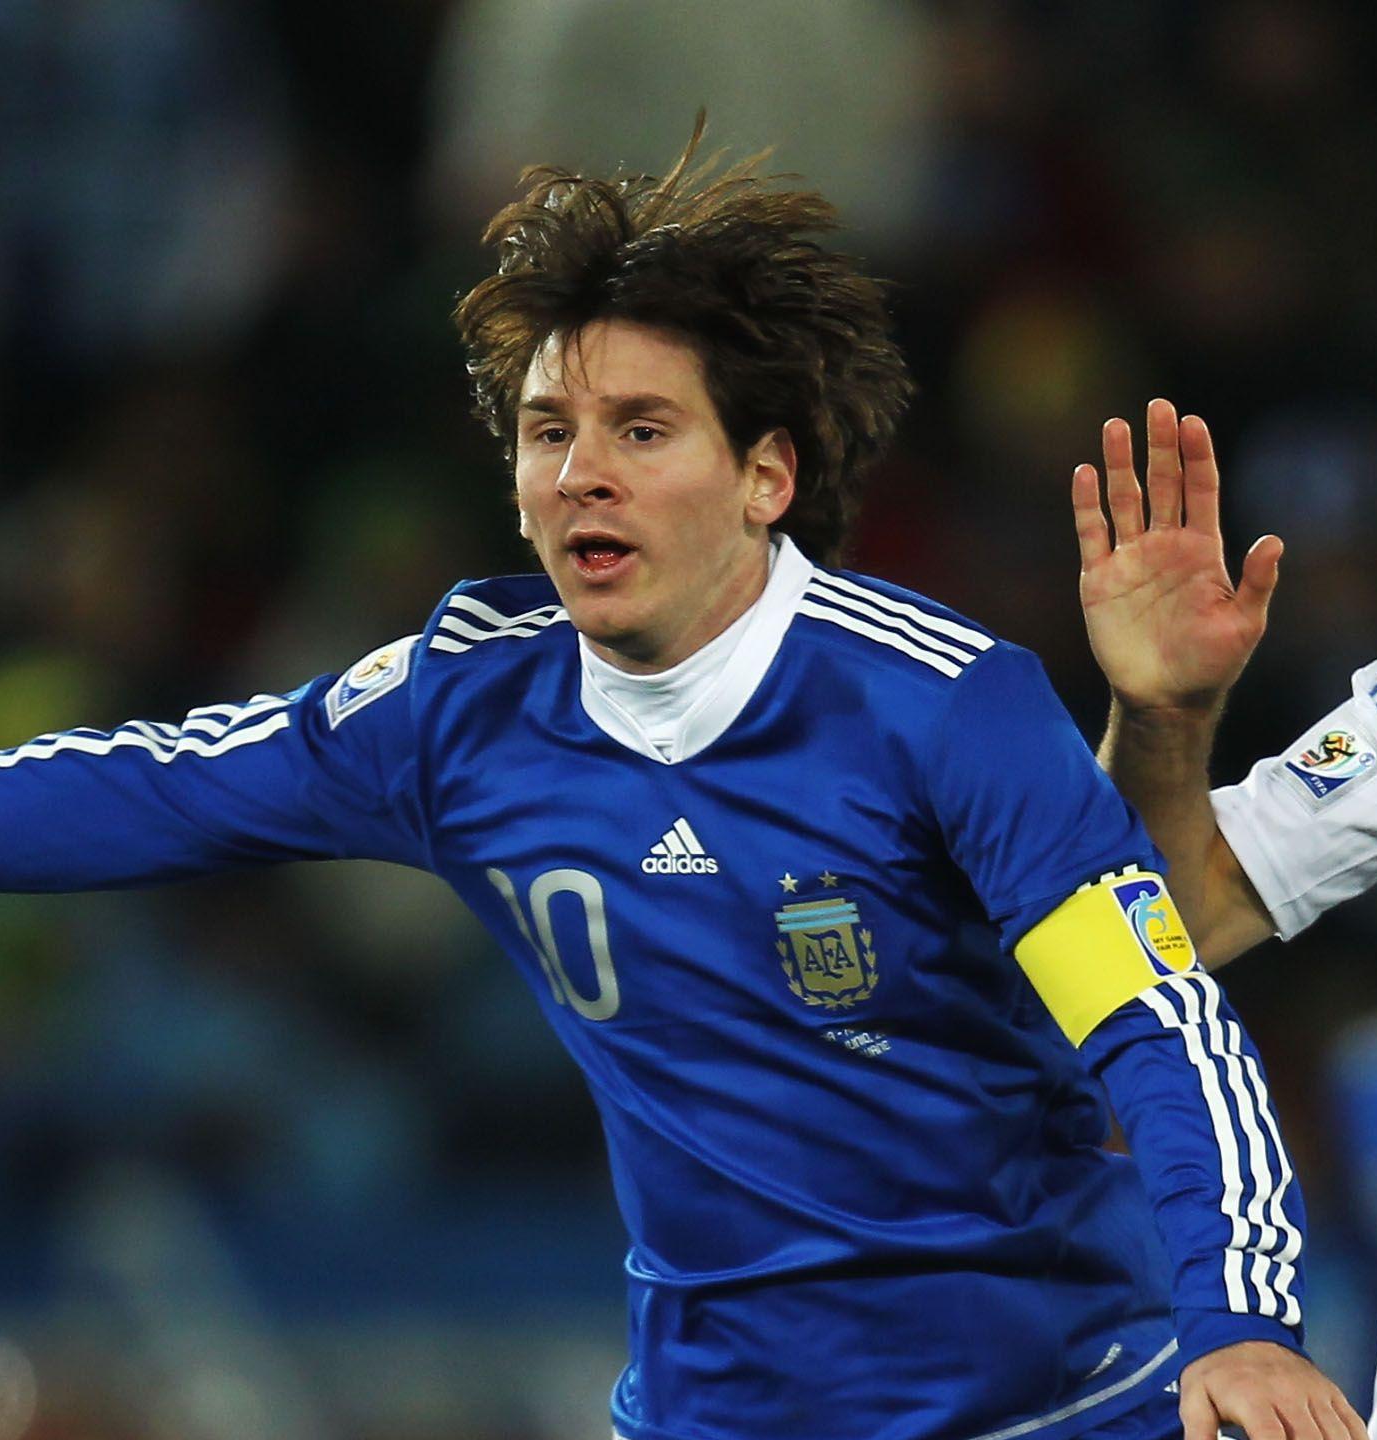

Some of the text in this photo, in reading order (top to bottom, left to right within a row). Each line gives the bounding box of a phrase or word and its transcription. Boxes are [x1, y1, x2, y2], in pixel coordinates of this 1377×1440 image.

[640, 853, 720, 875] adidas
[486, 867, 620, 1021] 10
[803, 928, 856, 979] AFA
